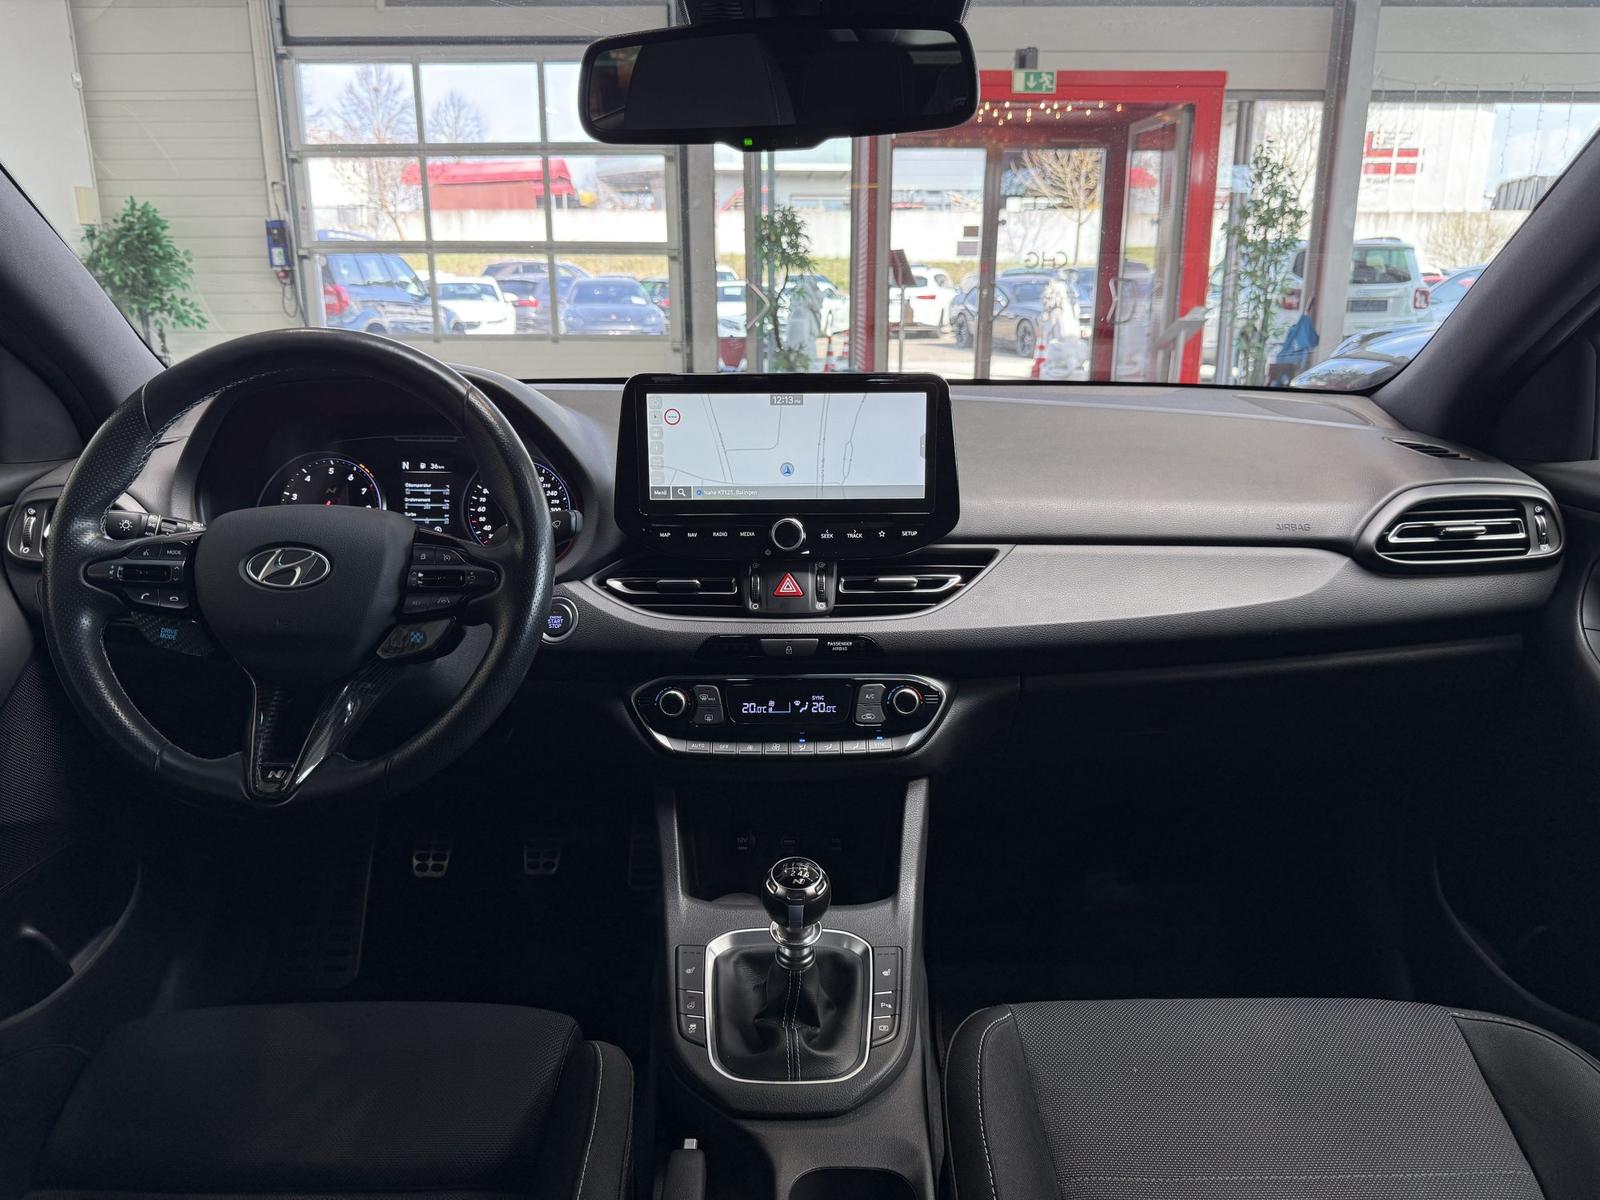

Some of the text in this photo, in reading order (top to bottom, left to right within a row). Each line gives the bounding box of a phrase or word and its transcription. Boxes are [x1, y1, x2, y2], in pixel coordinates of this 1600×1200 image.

[772, 396, 794, 405] 12:13
[402, 461, 410, 470] N
[328, 467, 335, 475] 5
[347, 473, 355, 481] 6
[361, 487, 368, 495] 7
[291, 493, 298, 501] 3
[1275, 523, 1312, 532] AIRBAG
[160, 627, 177, 635] DRIVE
[160, 632, 177, 641] MODE
